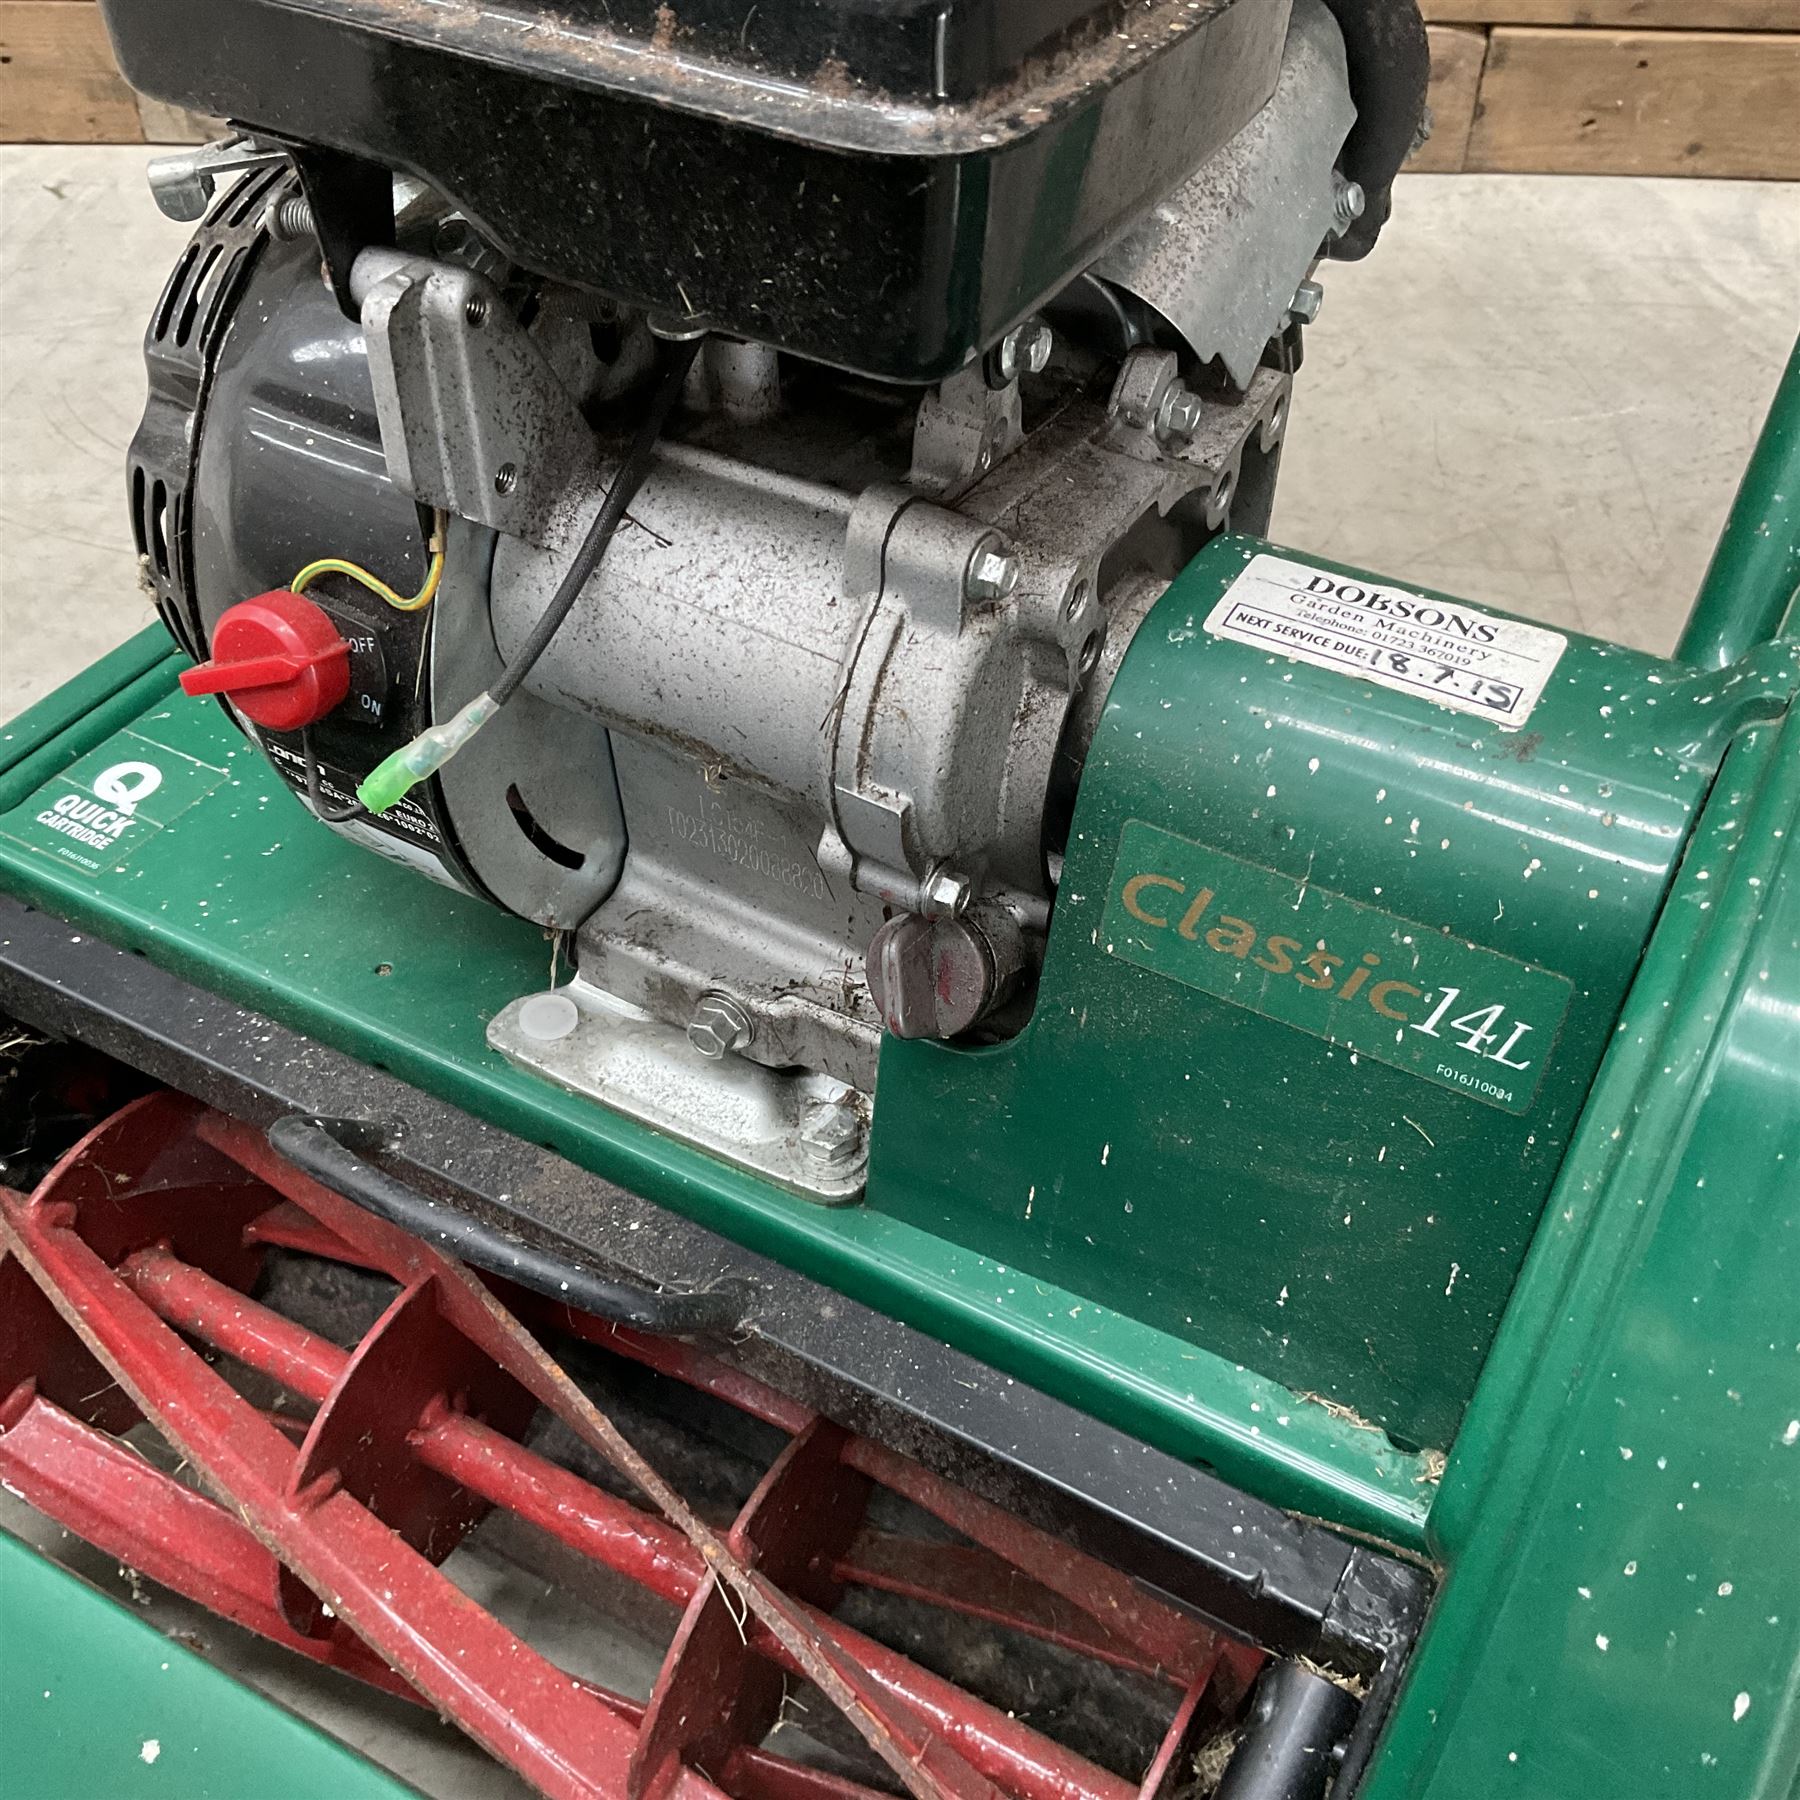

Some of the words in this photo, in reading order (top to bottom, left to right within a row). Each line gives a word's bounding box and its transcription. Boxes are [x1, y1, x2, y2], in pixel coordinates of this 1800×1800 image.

[1290, 593, 1364, 622] Garden
[1374, 618, 1492, 662] Machinery
[1304, 575, 1499, 643] DOBSONS
[349, 637, 375, 653] OFF
[1236, 611, 1273, 630] NEXT
[1273, 622, 1332, 648] SERVICE
[1333, 640, 1370, 660] DUE:
[1297, 608, 1368, 637] Telephone:
[1371, 630, 1415, 650] 01723
[1419, 644, 1472, 667] 367019
[361, 694, 381, 717] ON
[93, 761, 163, 816] Q
[36, 811, 114, 850] CARTRIDGE
[53, 794, 137, 839] QUICK
[395, 809, 427, 828] EURO
[1121, 873, 1421, 1022] Classic
[1410, 986, 1534, 1071] 14L
